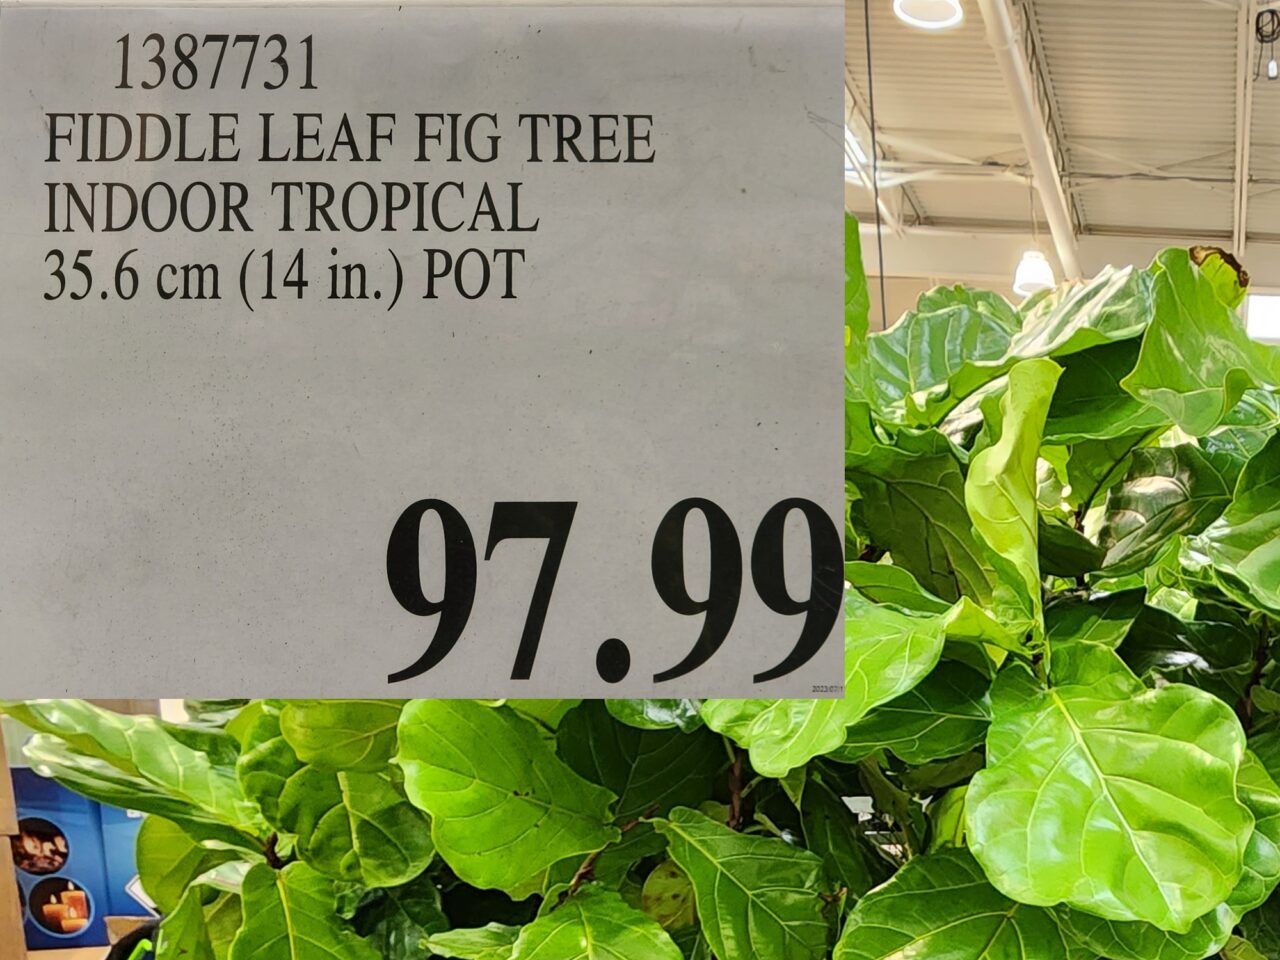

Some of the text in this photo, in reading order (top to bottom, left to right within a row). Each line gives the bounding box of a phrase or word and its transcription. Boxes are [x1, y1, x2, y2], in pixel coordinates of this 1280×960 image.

[114, 34, 318, 91] 1387731
[44, 112, 656, 164] FIDDLE LEAF FIG TREE
[44, 181, 540, 233] INDOOR TROPICAL
[43, 247, 526, 312] 35.6 cm (14 in.) POT
[386, 497, 844, 684] 97.99
